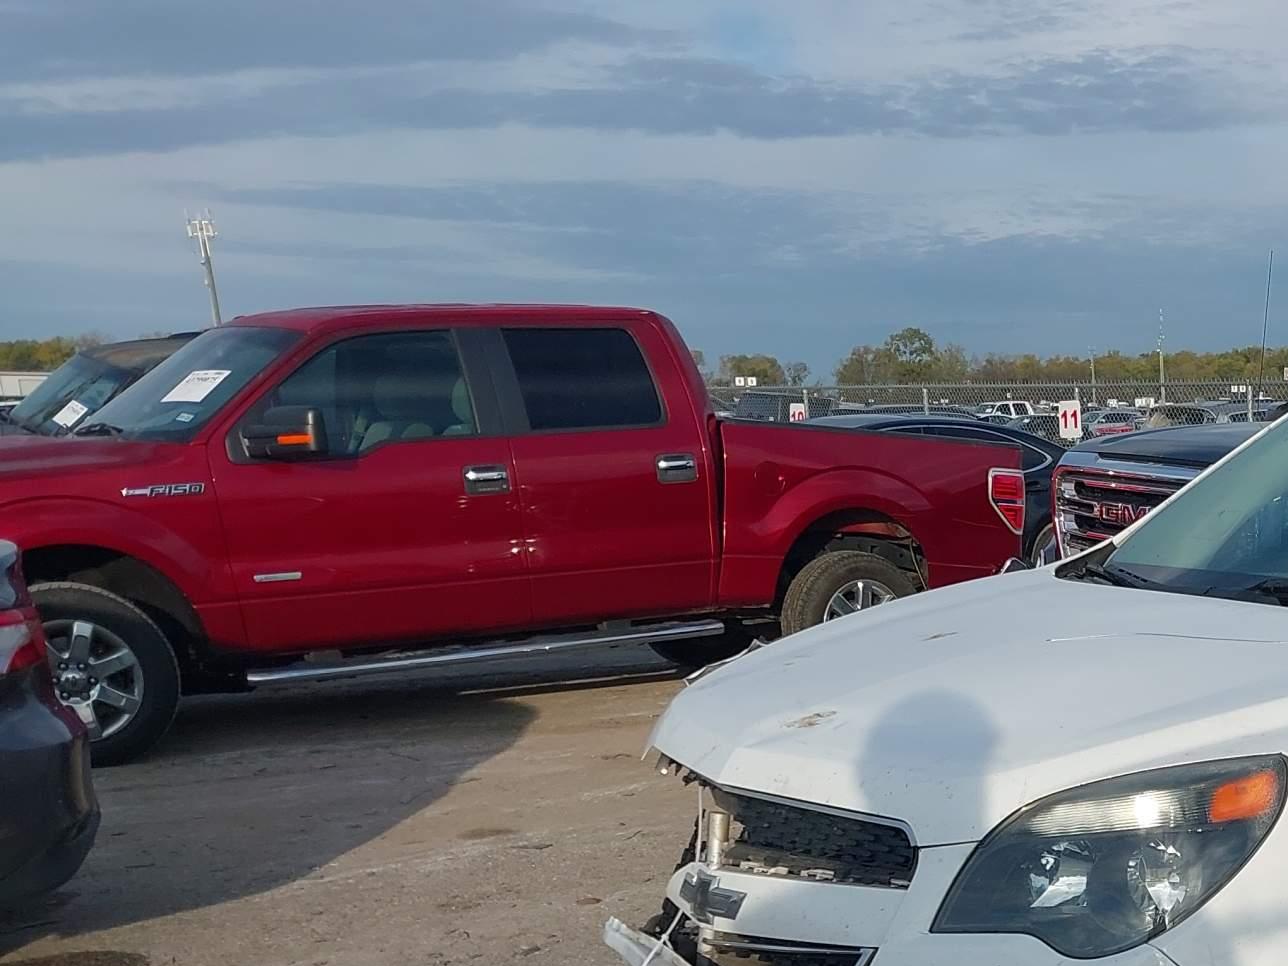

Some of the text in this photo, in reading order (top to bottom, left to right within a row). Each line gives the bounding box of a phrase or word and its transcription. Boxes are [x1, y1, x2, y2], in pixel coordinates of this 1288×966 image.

[791, 410, 804, 422] 10
[1061, 409, 1078, 429] 11
[1100, 500, 1152, 526] GM
